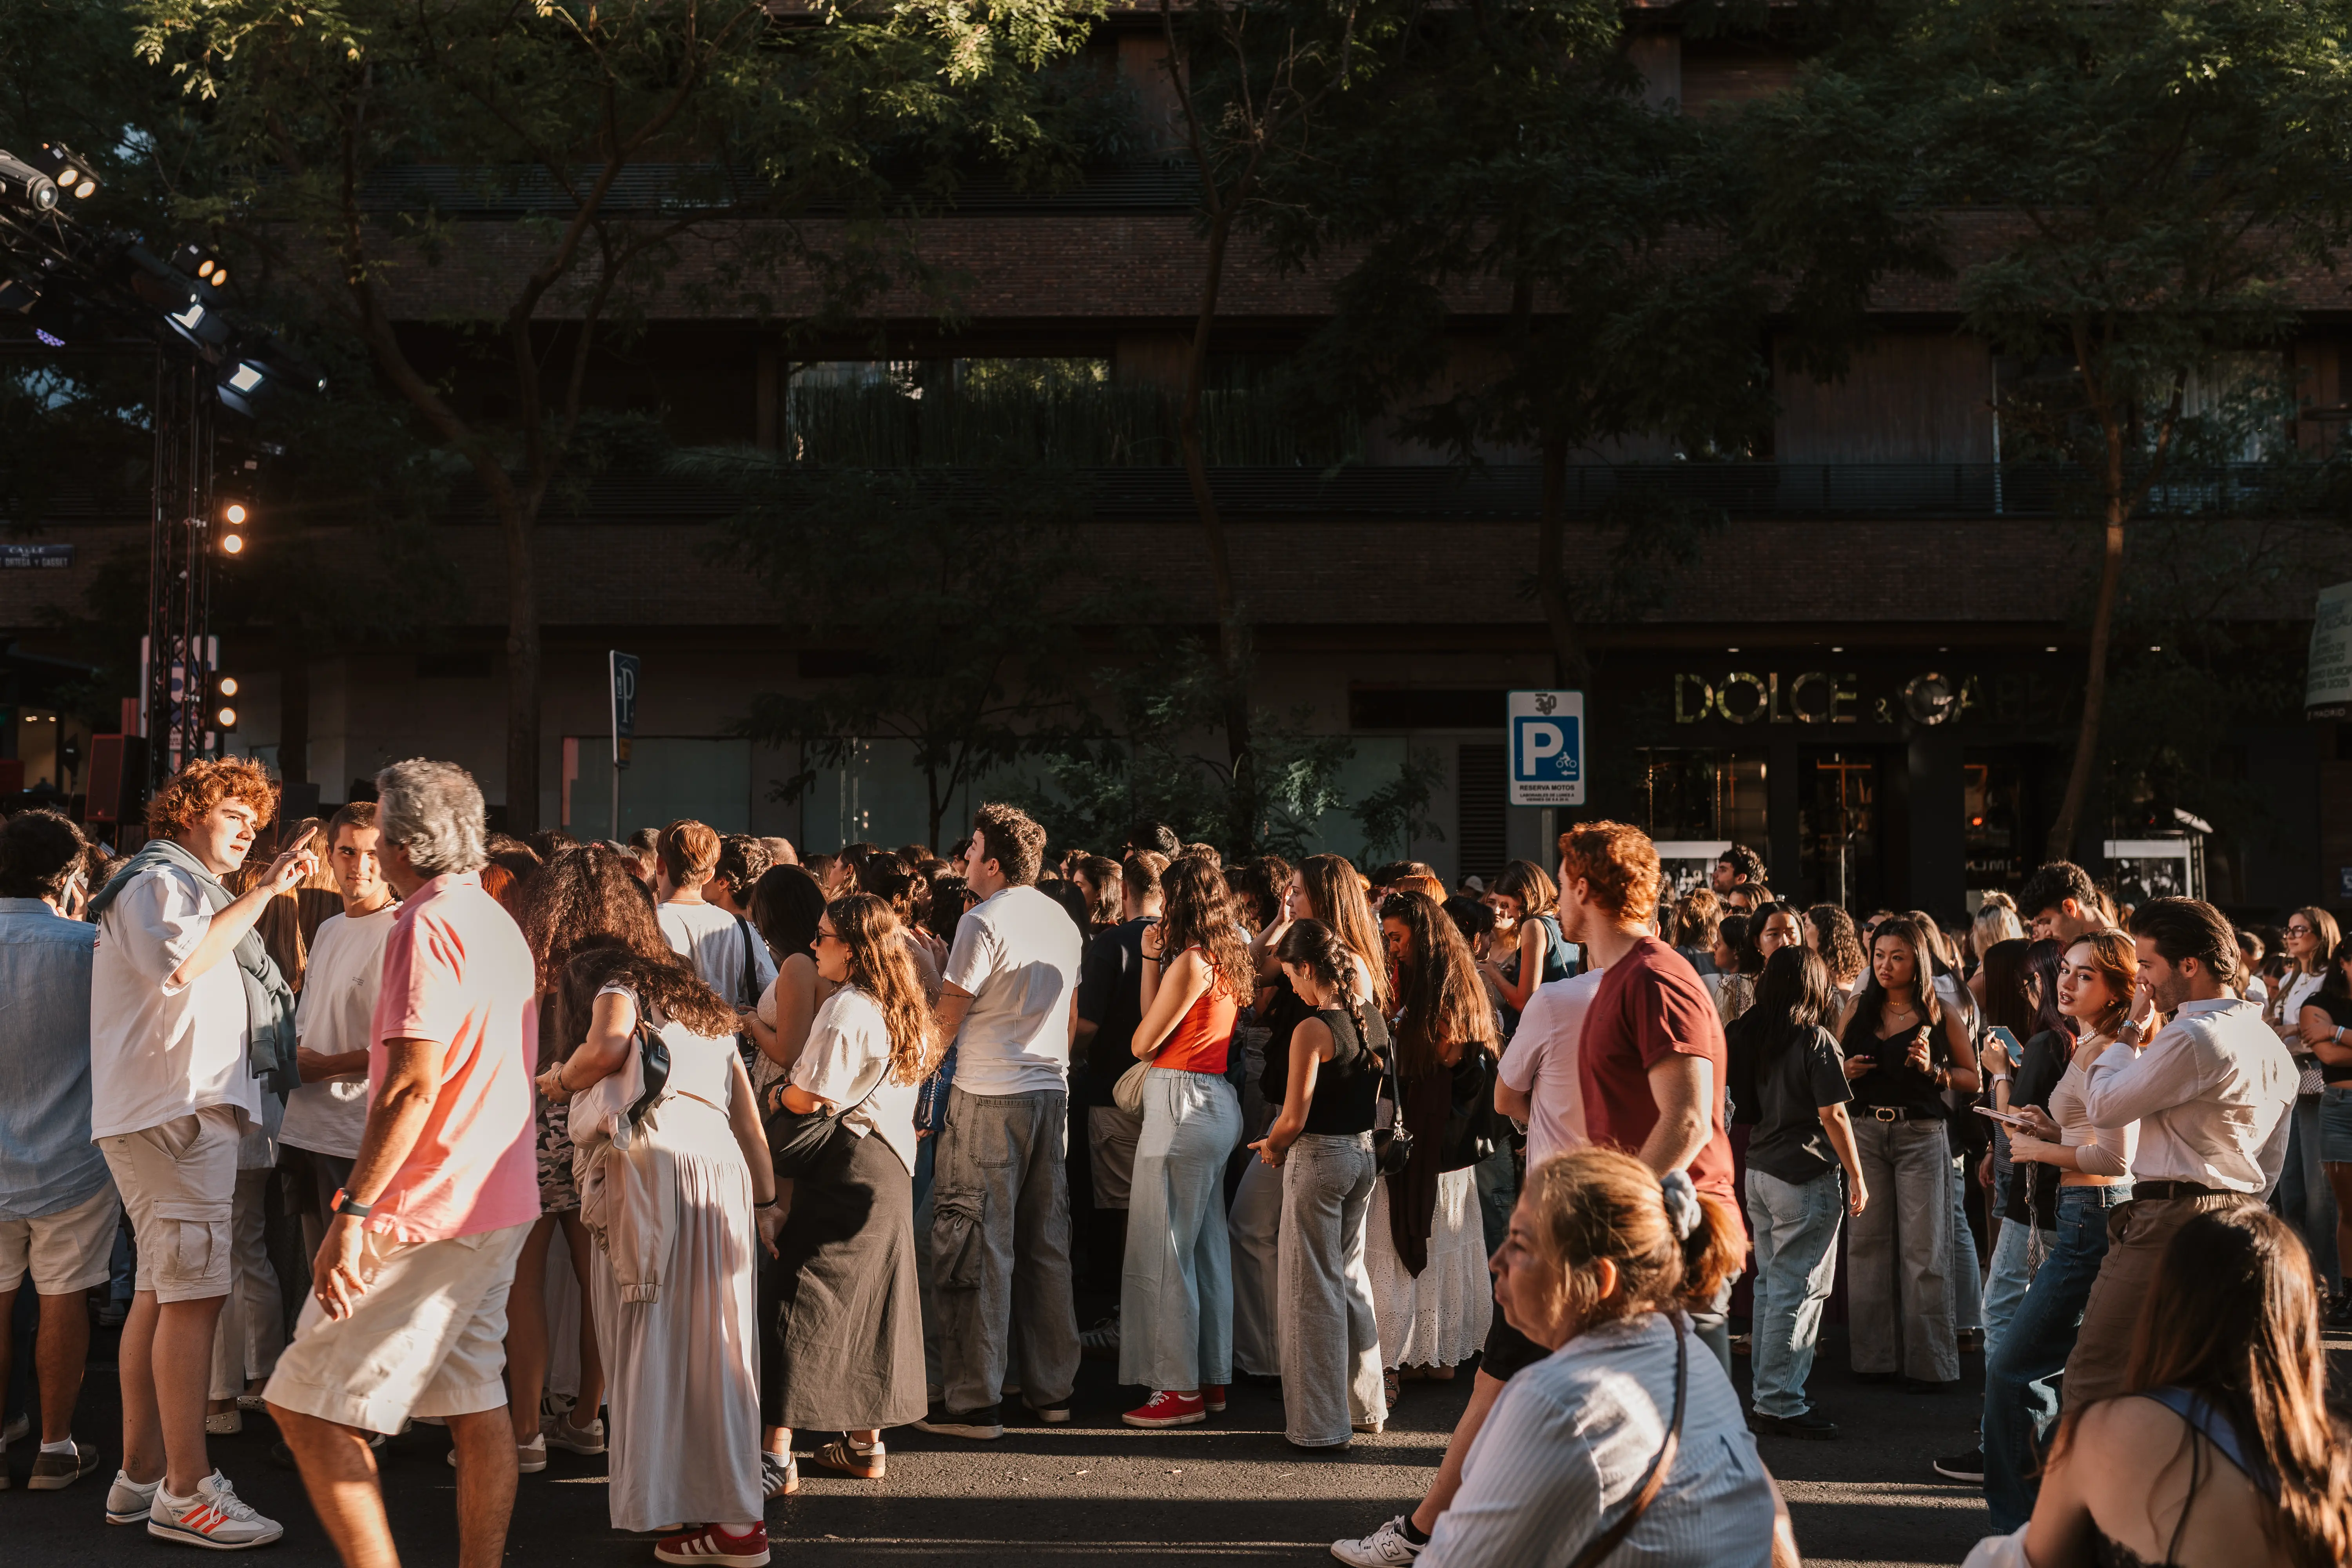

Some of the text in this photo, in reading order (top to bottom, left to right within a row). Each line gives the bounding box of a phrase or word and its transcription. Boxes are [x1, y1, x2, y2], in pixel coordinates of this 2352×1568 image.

[42, 557, 67, 567] GASSET
[620, 667, 634, 723] P
[1675, 671, 1857, 725] DOLCE
[1873, 697, 1893, 724] &
[1522, 722, 1564, 775] P
